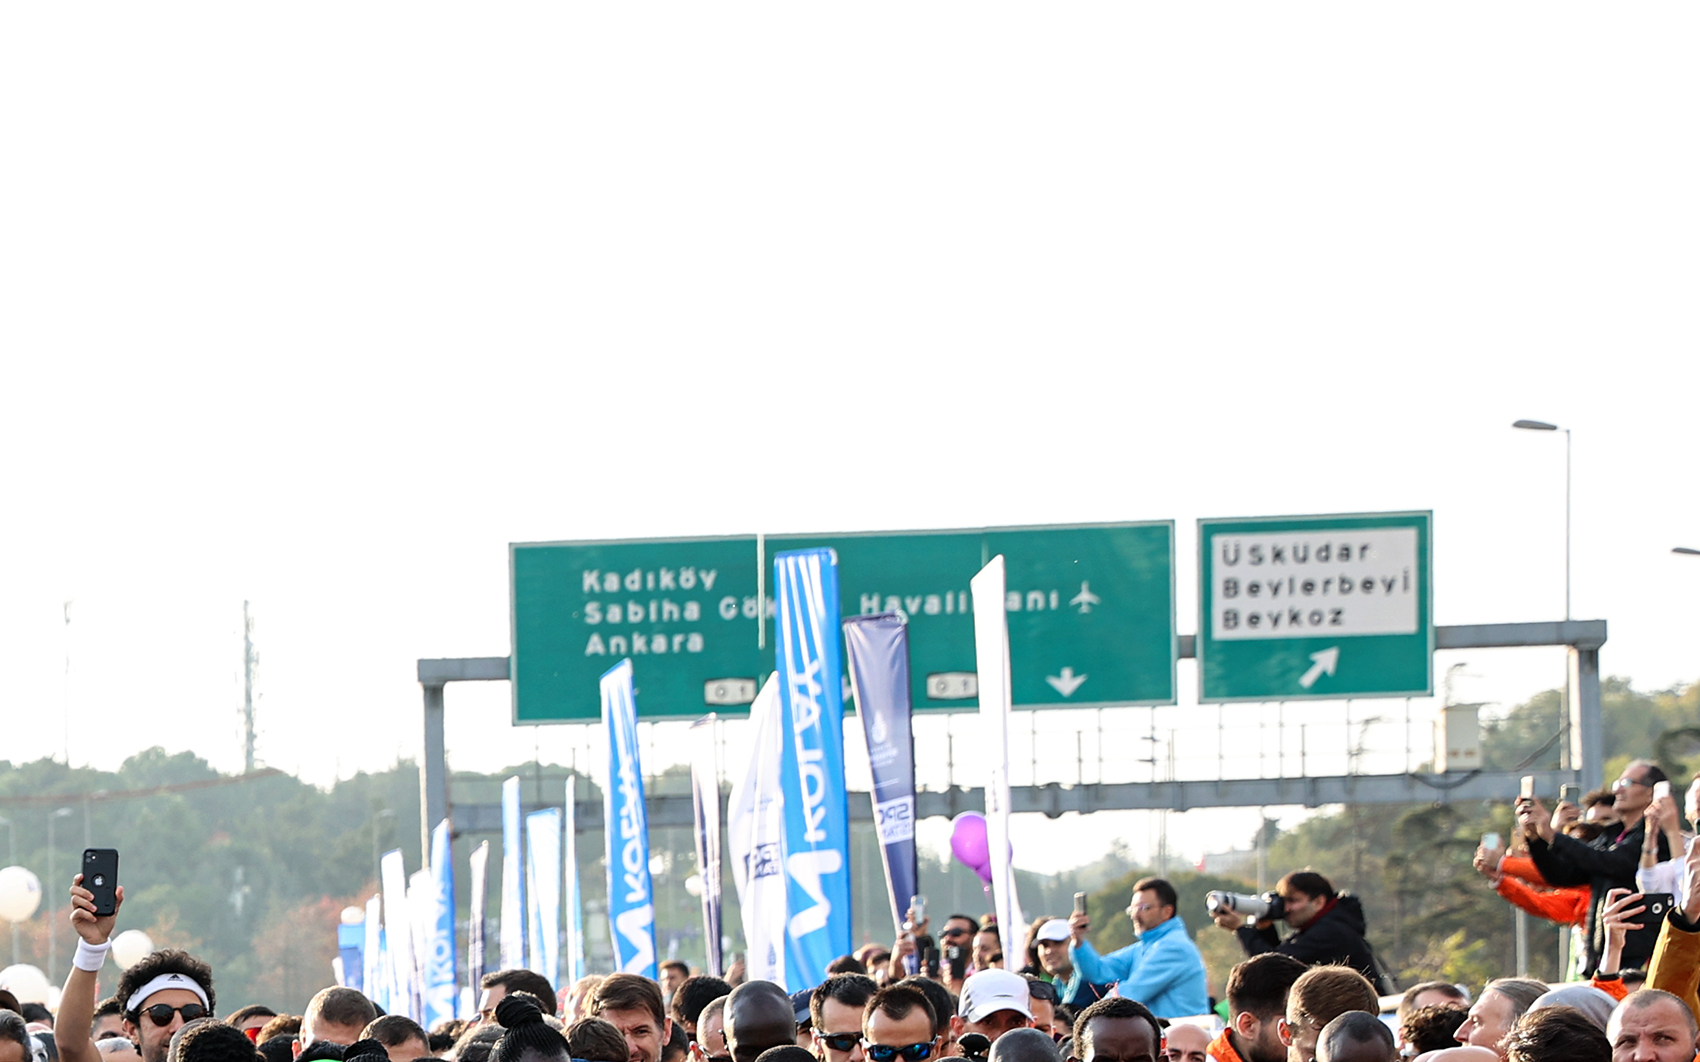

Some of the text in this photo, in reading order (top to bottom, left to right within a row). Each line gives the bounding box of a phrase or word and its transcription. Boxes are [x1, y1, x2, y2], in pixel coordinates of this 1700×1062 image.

[582, 566, 718, 593] Kadıköy
[1221, 569, 1411, 599] Beylerbeyi
[718, 595, 776, 620] Gök
[859, 590, 1059, 616] Havalianı
[1221, 607, 1344, 630] Beykoz
[585, 631, 704, 656] Ankara
